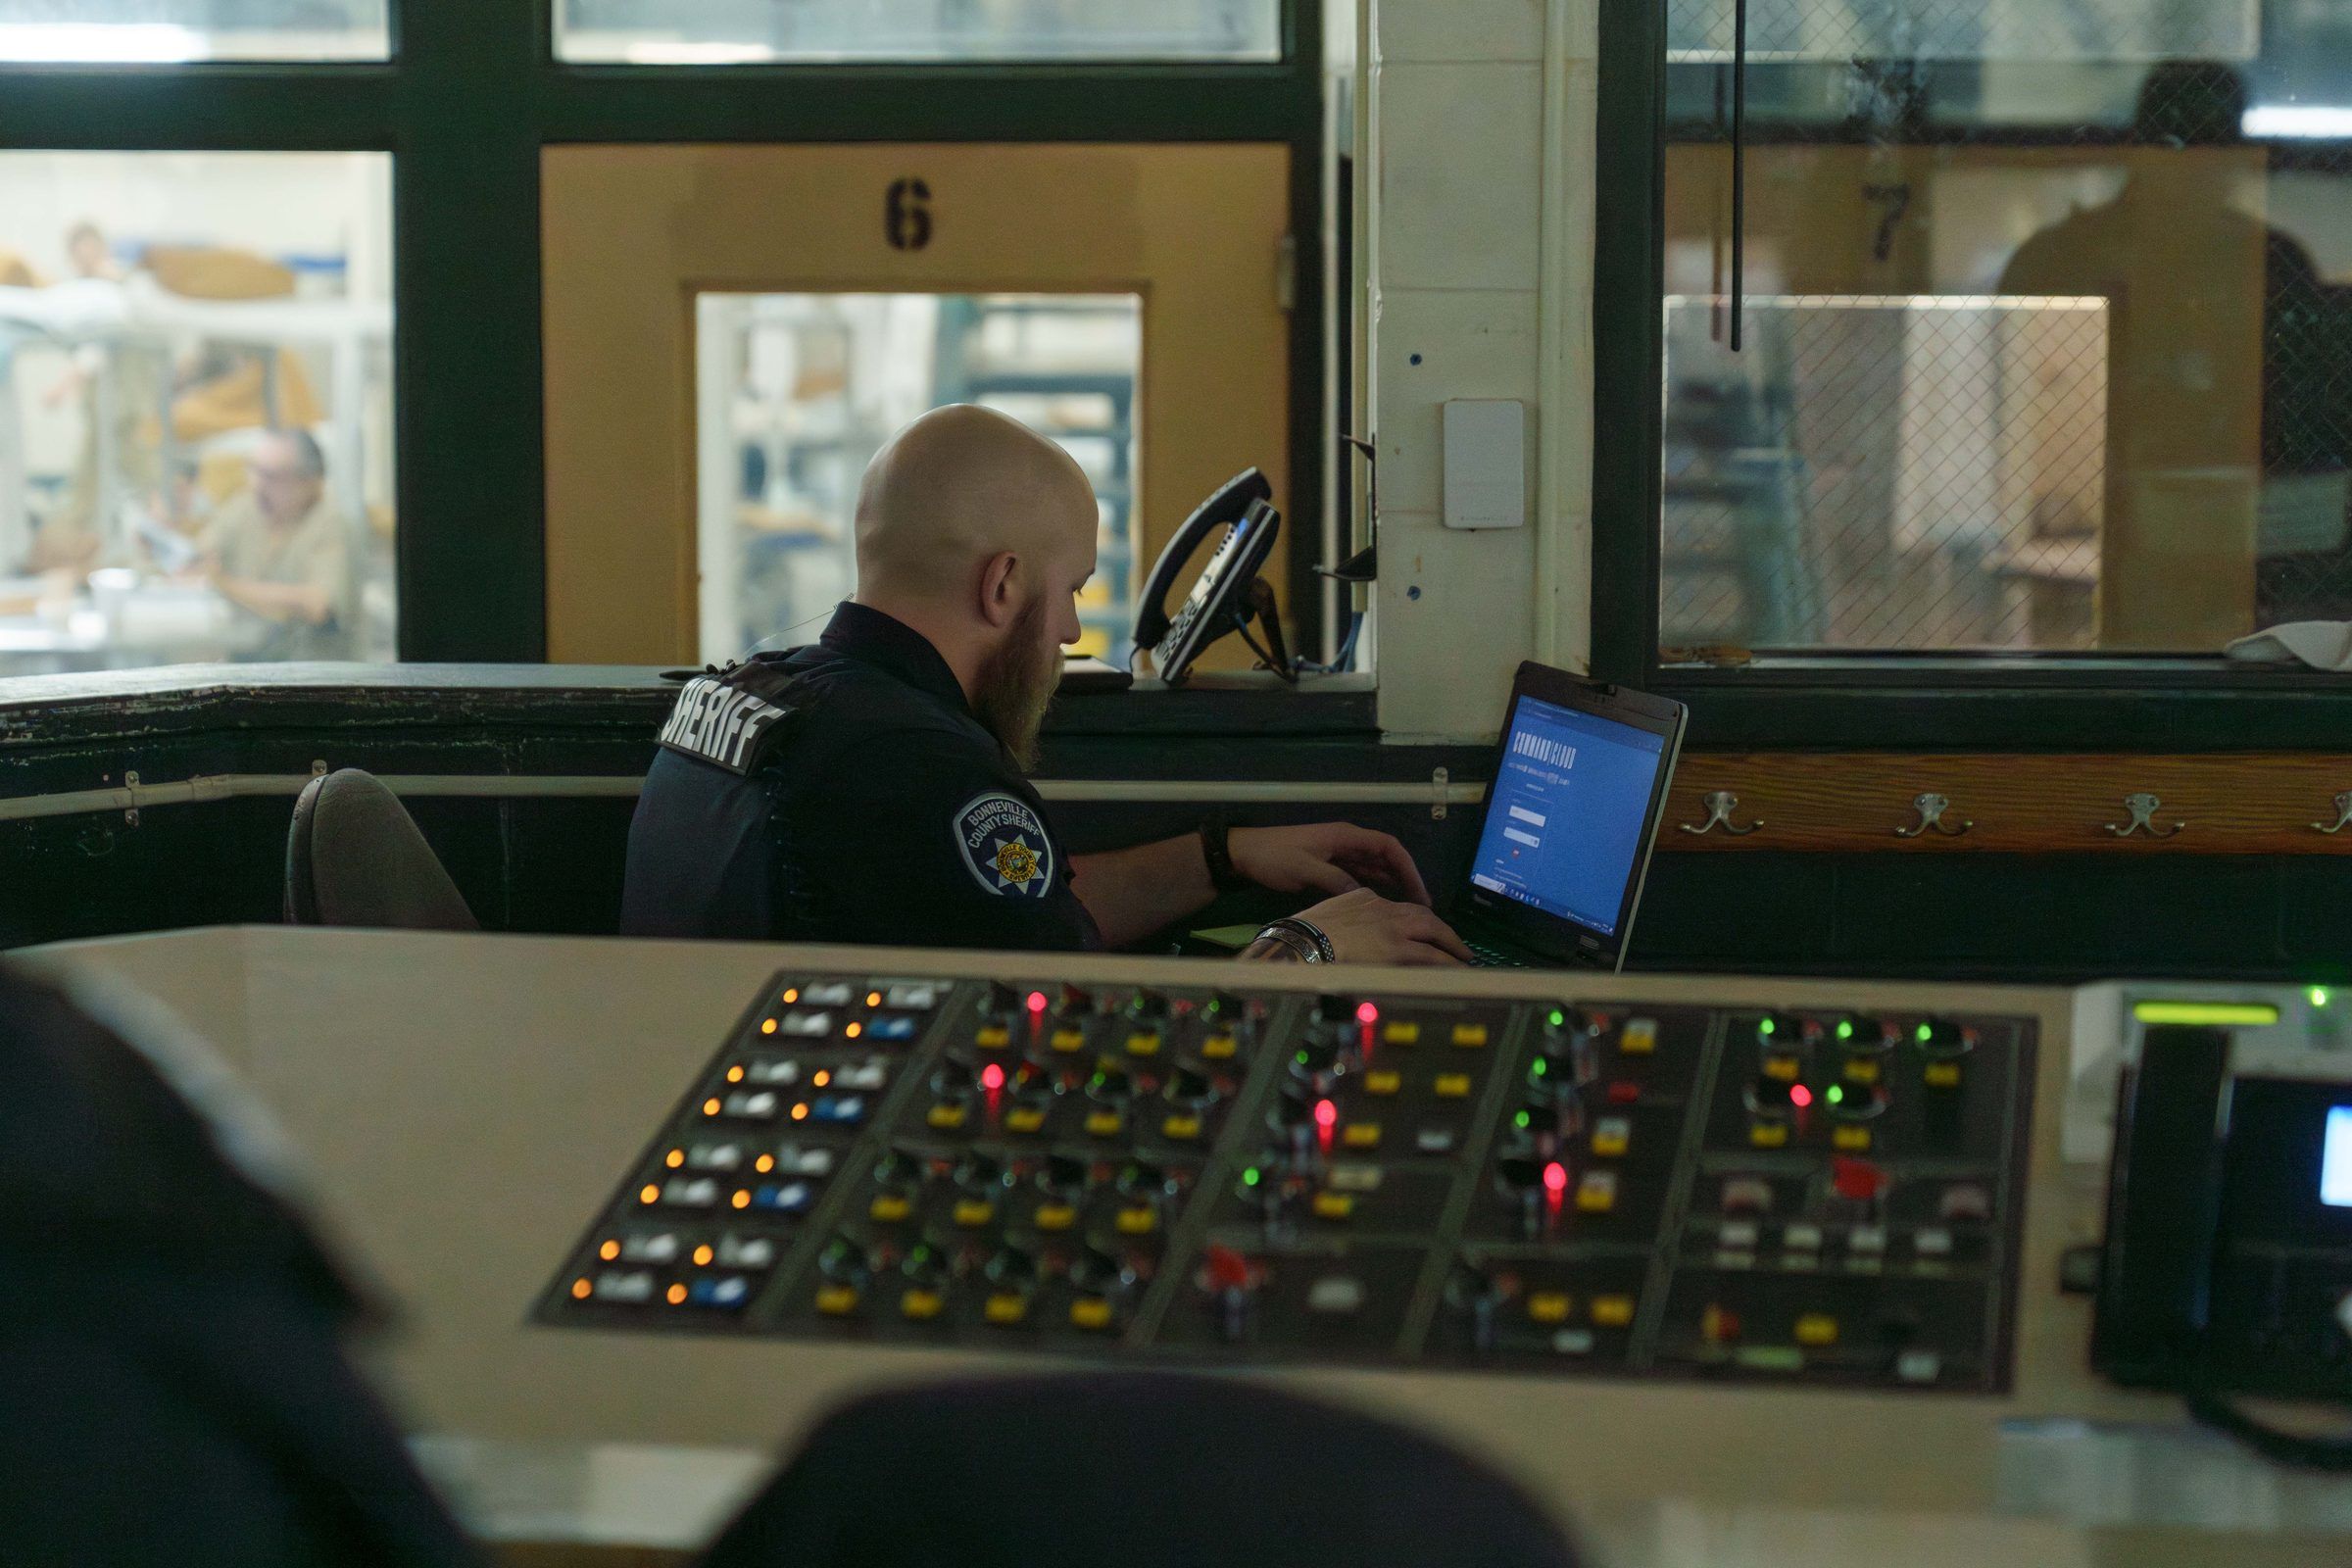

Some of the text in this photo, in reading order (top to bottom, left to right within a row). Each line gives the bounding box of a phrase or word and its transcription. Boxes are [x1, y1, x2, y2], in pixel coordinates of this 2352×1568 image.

[886, 178, 932, 252] 6
[662, 679, 786, 766] SHERIFF
[968, 802, 1028, 826] BONNEVILLE
[968, 813, 1041, 849] COUNTY SHERIFF
